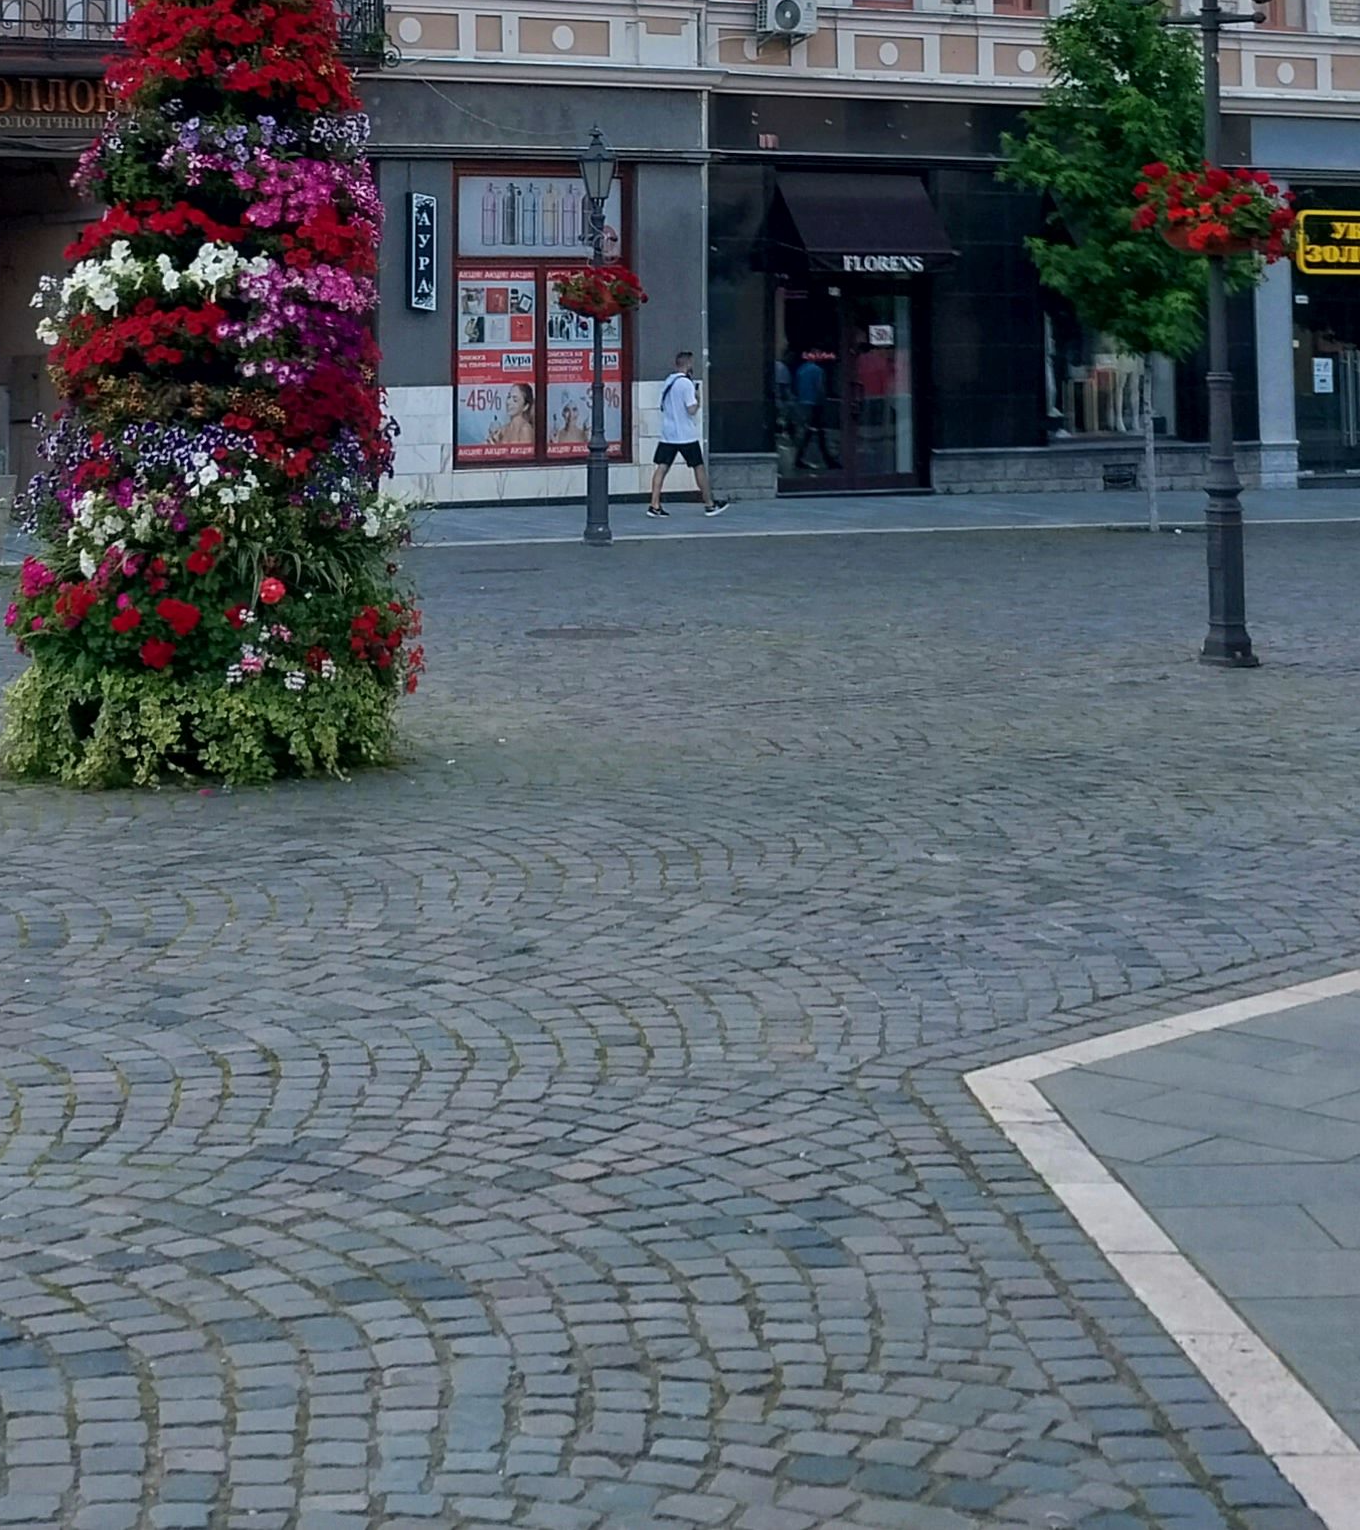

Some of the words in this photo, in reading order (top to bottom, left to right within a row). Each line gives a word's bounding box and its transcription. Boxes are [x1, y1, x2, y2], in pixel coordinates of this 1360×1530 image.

[417, 211, 431, 293] АУРА
[843, 255, 924, 272] FLORENS
[504, 355, 531, 367] Аура
[460, 389, 501, 411] -45%
[580, 387, 619, 408] -3%
